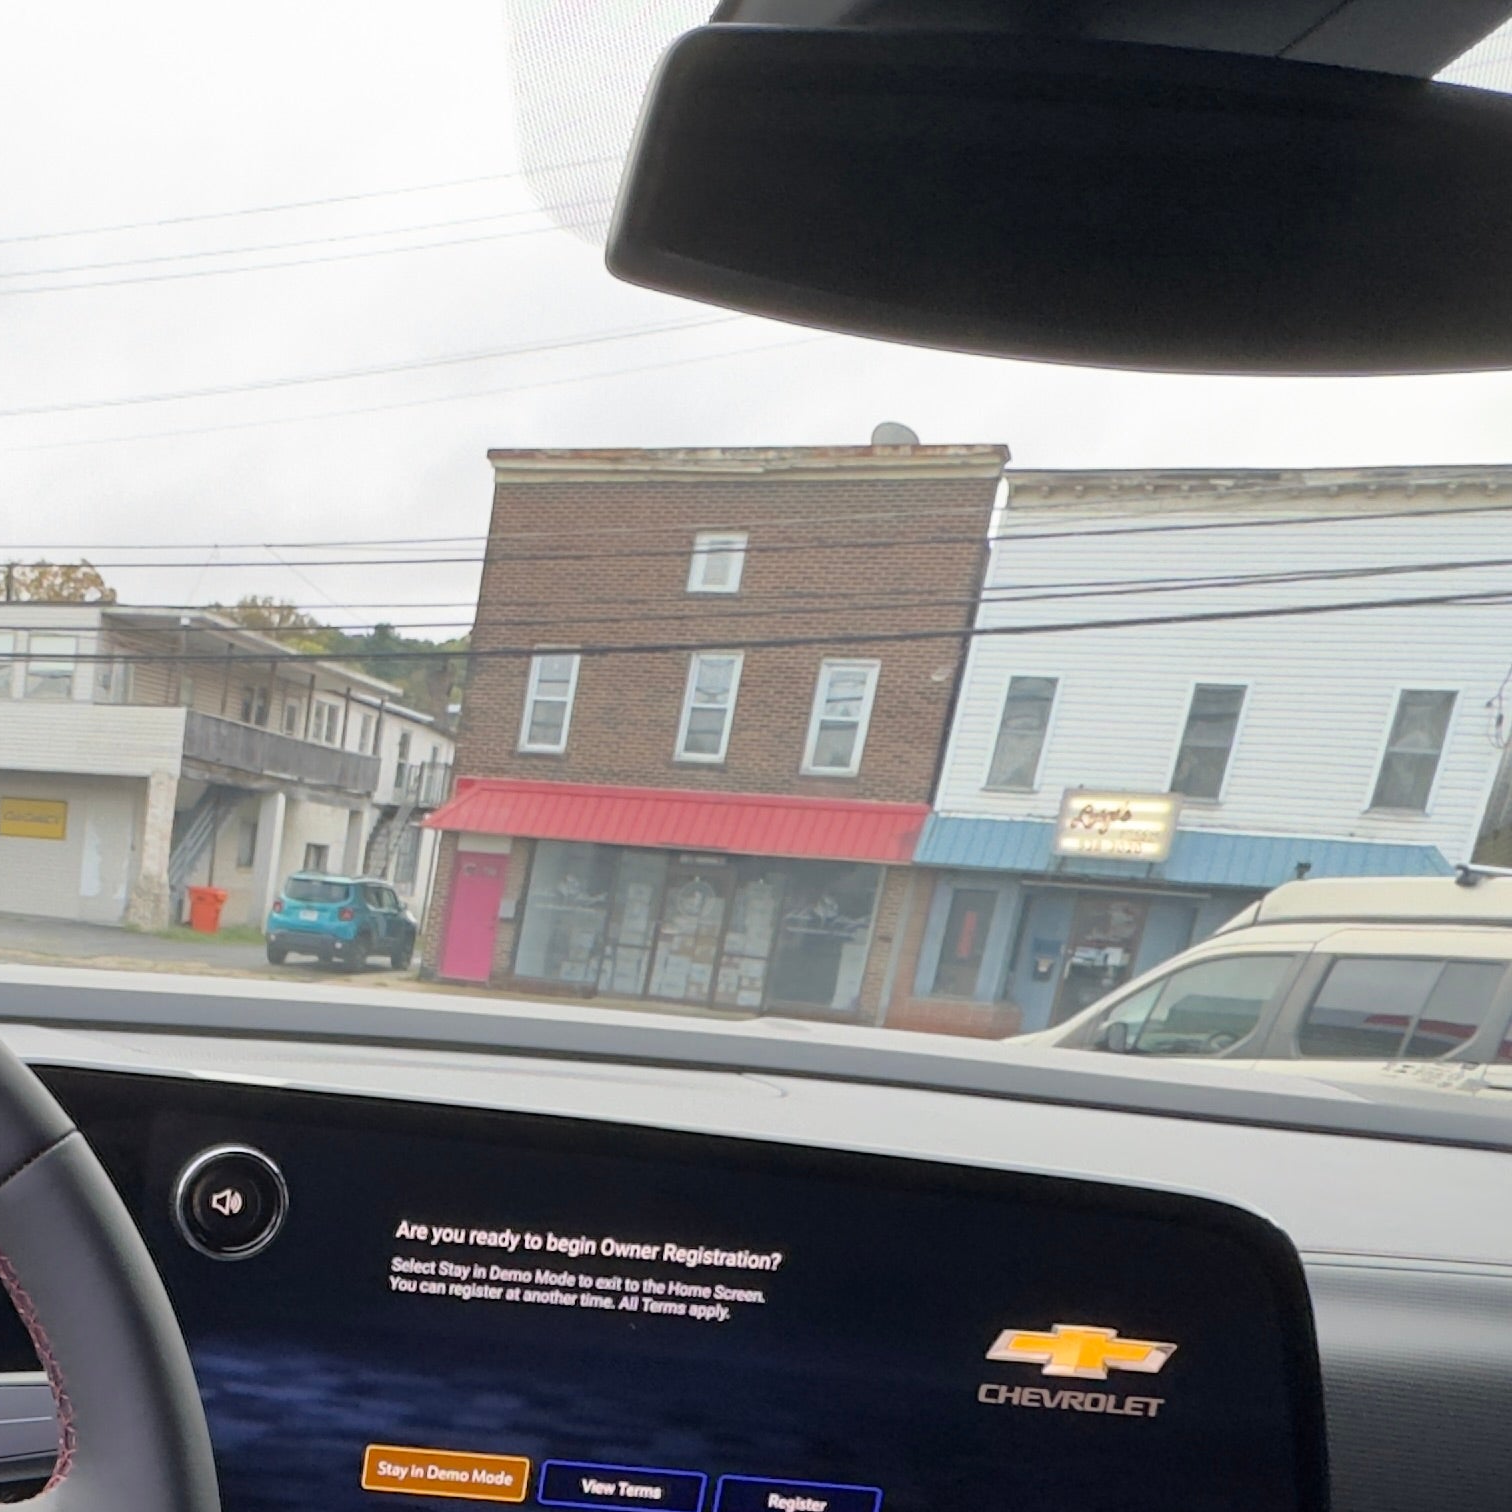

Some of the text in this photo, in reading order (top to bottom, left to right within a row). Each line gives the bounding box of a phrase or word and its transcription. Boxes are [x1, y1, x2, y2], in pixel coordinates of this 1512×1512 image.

[395, 1219, 783, 1272] Are you ready to begin Owner Registration?
[389, 1274, 732, 1323] You can register at another time. All Terms apply.
[390, 1256, 766, 1305] Select Stay in Demo Mode to exit to the Home Screen.
[976, 1382, 1166, 1418] CHEVROLET
[377, 1459, 514, 1488] Stay in Demo Mode
[581, 1477, 663, 1501] View Terms
